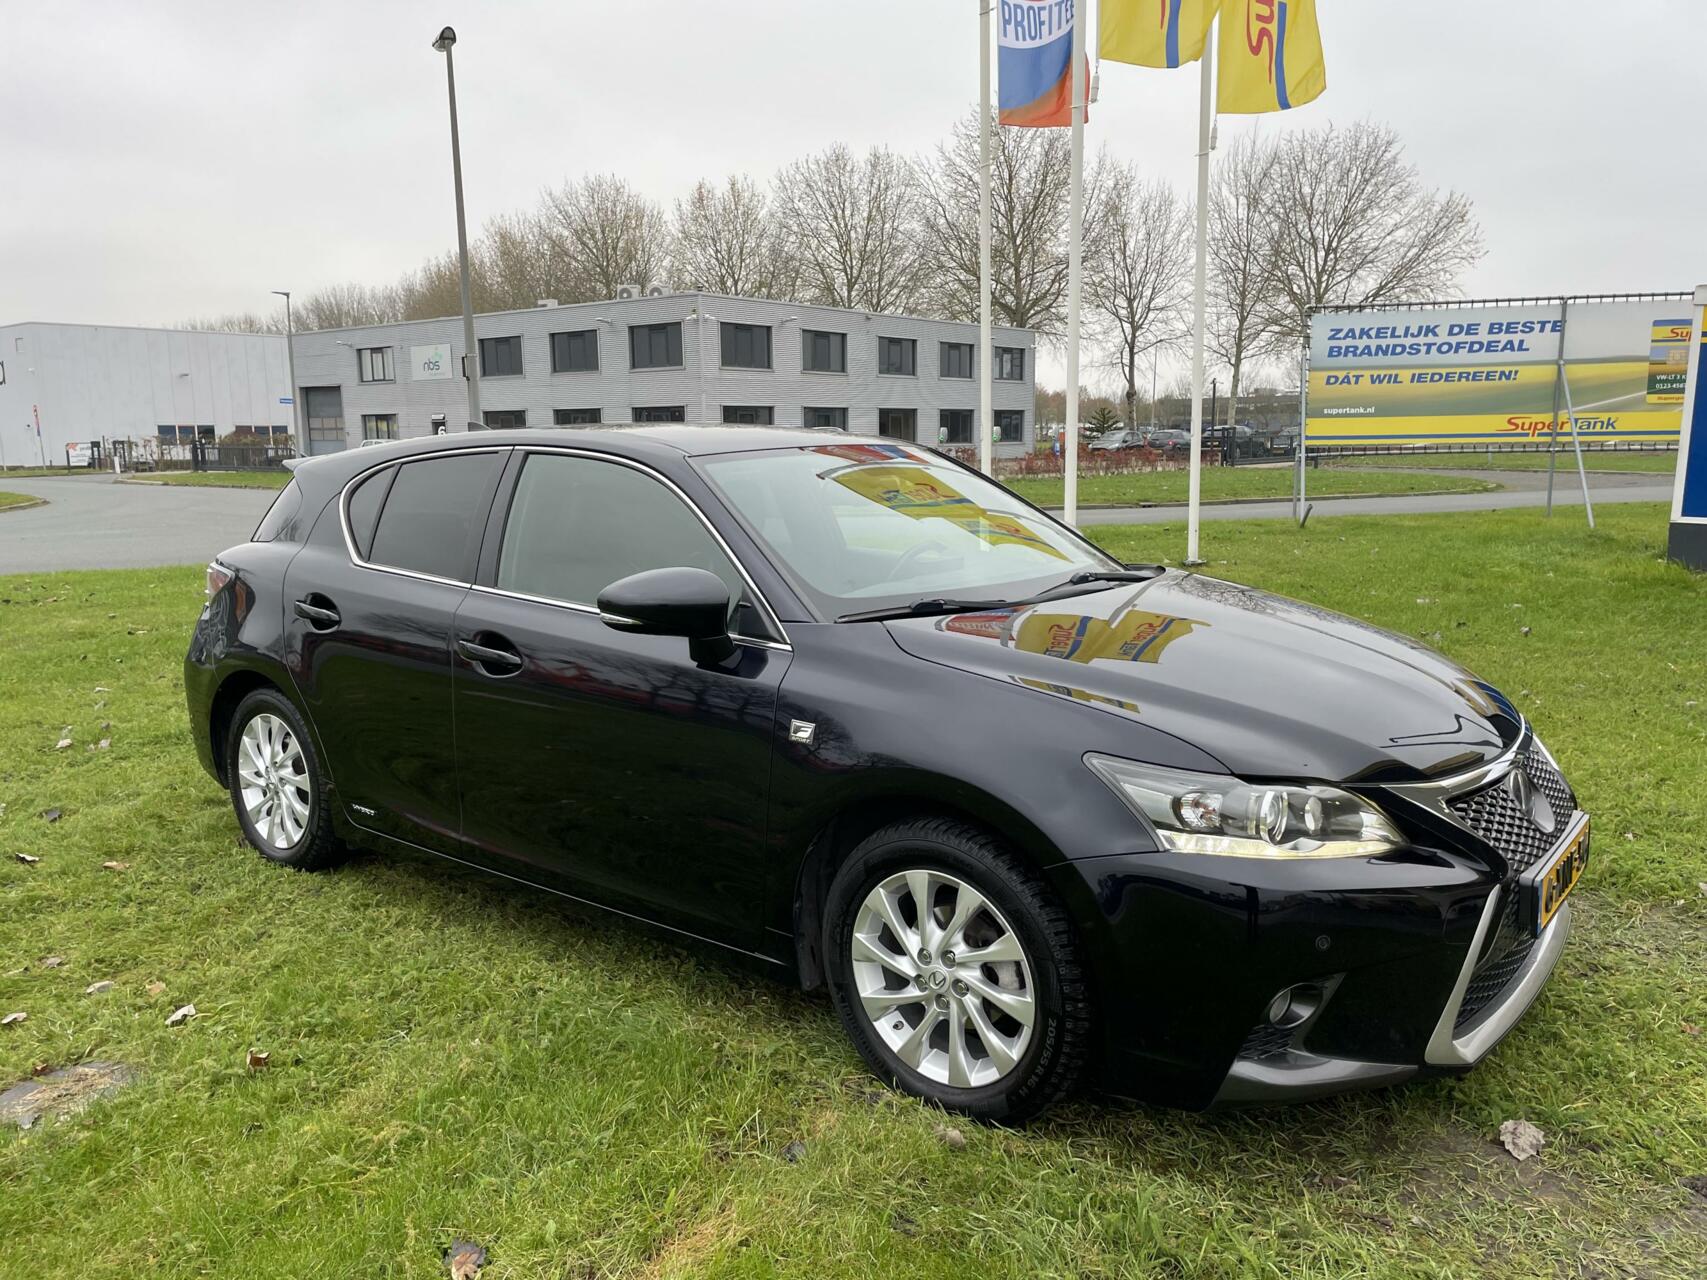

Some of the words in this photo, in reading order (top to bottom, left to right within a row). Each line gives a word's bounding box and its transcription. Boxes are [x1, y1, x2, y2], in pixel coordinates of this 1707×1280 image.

[1327, 325, 1441, 341] ZAKELIJK
[1447, 323, 1481, 336] DE
[1487, 320, 1566, 335] BESTE
[1327, 339, 1530, 358] BRANDSTOFDEAL
[423, 358, 440, 371] nbs
[1325, 372, 1364, 386] DÁT
[1369, 373, 1404, 385] WIL
[1409, 370, 1519, 384] IEDEREEN!
[1323, 406, 1376, 416] supertank.nl
[1496, 416, 1619, 437] SuperTank
